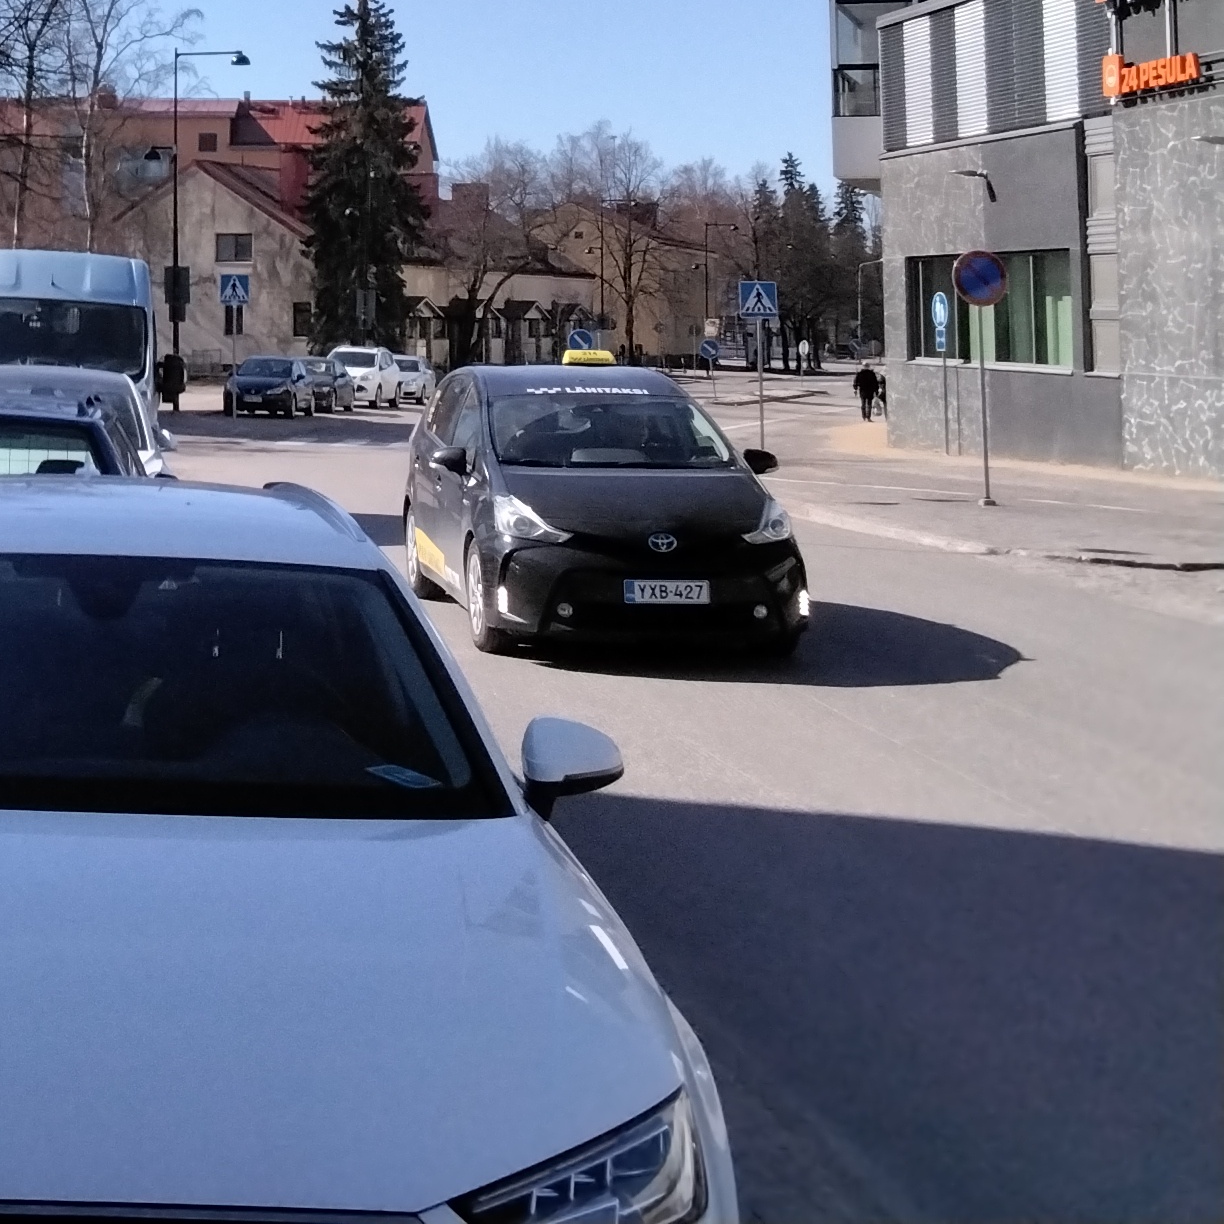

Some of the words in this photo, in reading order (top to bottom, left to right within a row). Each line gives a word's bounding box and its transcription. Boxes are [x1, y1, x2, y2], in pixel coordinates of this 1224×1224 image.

[1121, 65, 1138, 93] 24
[1140, 53, 1197, 90] PESULA
[638, 583, 704, 600] YXB-427
